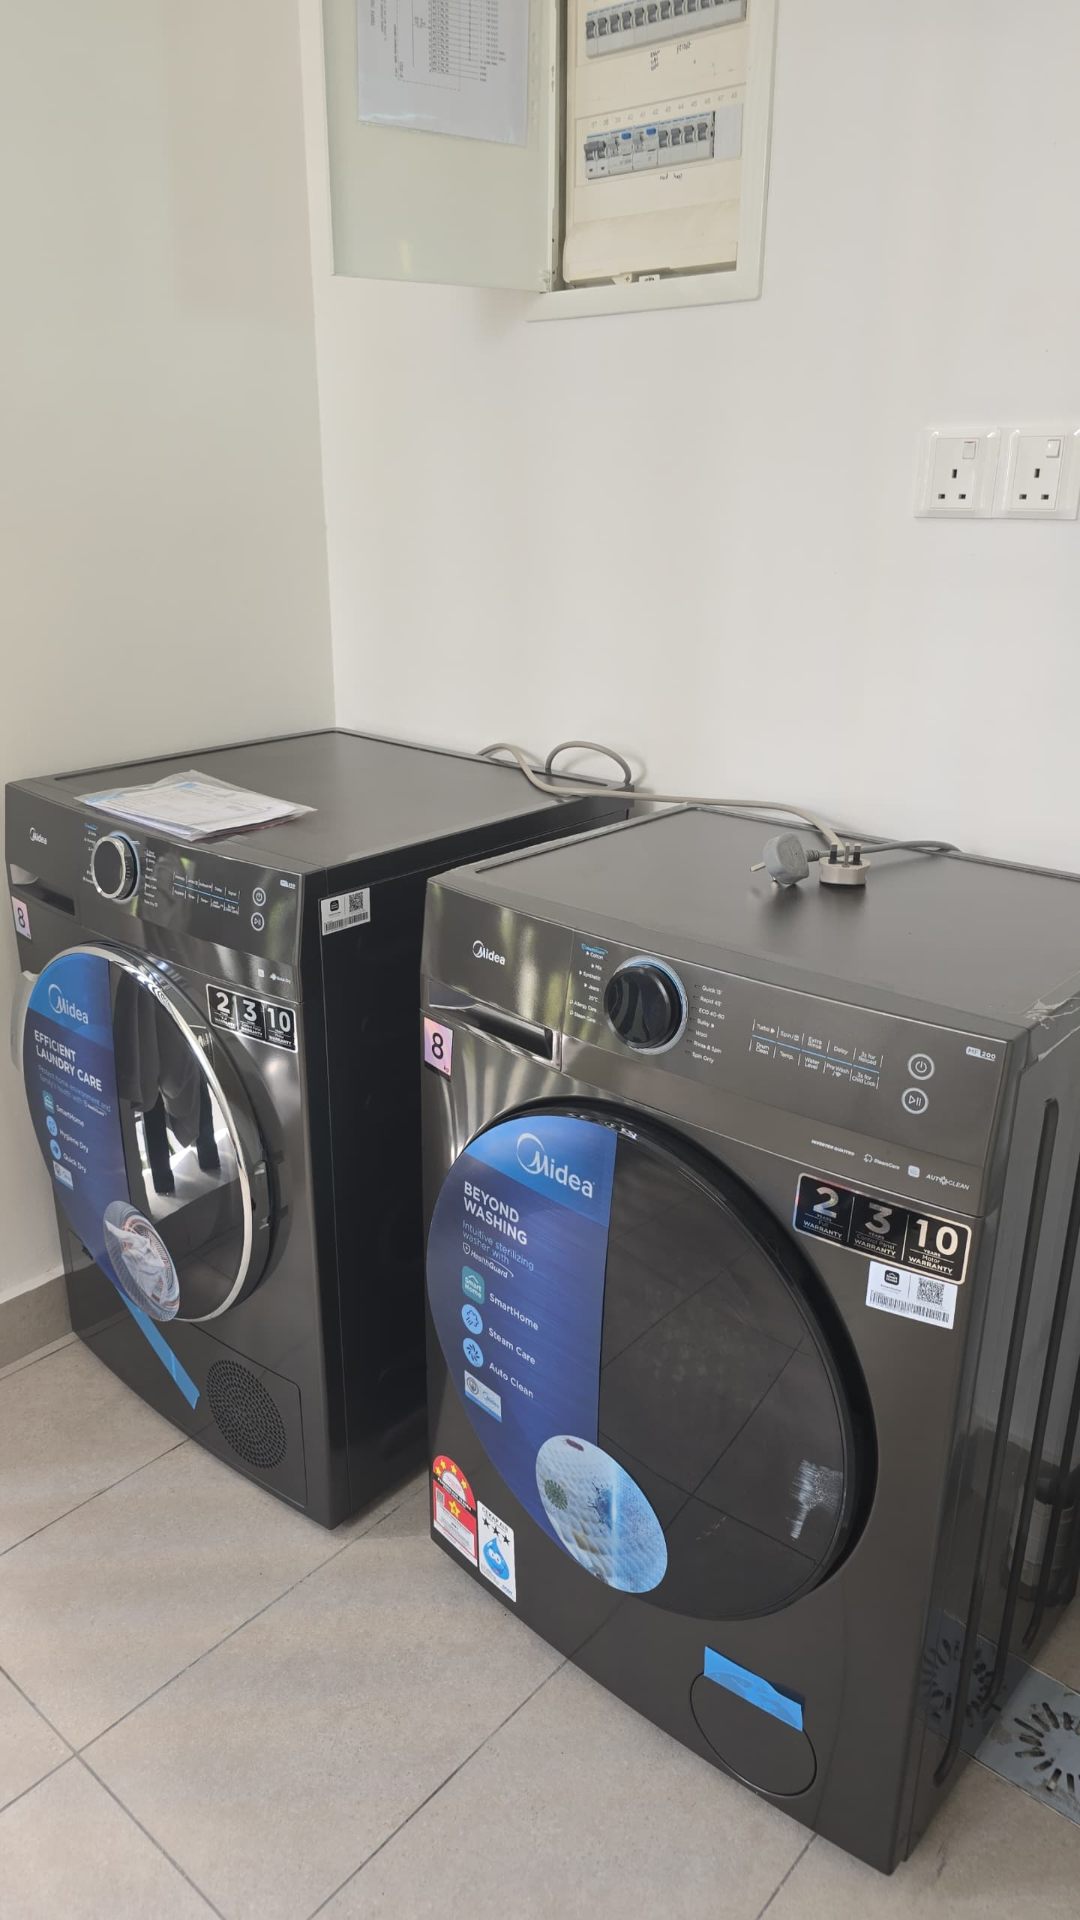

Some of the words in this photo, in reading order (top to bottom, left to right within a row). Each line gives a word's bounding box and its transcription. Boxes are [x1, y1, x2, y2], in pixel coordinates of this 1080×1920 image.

[17, 907, 26, 928] 8
[472, 940, 506, 965] Midea
[49, 984, 89, 1024] Midea
[216, 992, 230, 1014] 2
[700, 996, 714, 1005] Rapid
[701, 984, 716, 994] Quick
[243, 1000, 257, 1021] 3
[268, 1008, 291, 1033] 10
[698, 1007, 709, 1015] ECO
[34, 1030, 76, 1062] EFFICIENT
[432, 1032, 444, 1060] 8
[36, 1045, 75, 1077] LAUNDRY
[77, 1069, 103, 1092] CARE
[517, 1133, 595, 1199] Midea
[464, 1181, 520, 1223] BEYOND
[813, 1186, 839, 1218] 2
[464, 1197, 528, 1246] WASHING
[803, 1219, 843, 1239] WARRANTY
[864, 1202, 893, 1235] 3
[462, 1219, 494, 1246] Intuitive
[495, 1242, 534, 1272] sterilizing
[463, 1230, 490, 1252] washer
[492, 1249, 510, 1265] with
[854, 1238, 896, 1257] WARRANTY
[916, 1218, 959, 1256] 10
[908, 1255, 953, 1275] WARRANTY
[922, 1254, 940, 1264] Motor
[923, 1248, 941, 1257] YEARS
[489, 1293, 539, 1331] SmartHome
[488, 1327, 514, 1351] Steam
[515, 1346, 536, 1365] Care
[489, 1362, 509, 1381] Auto
[510, 1377, 534, 1399] Clean
